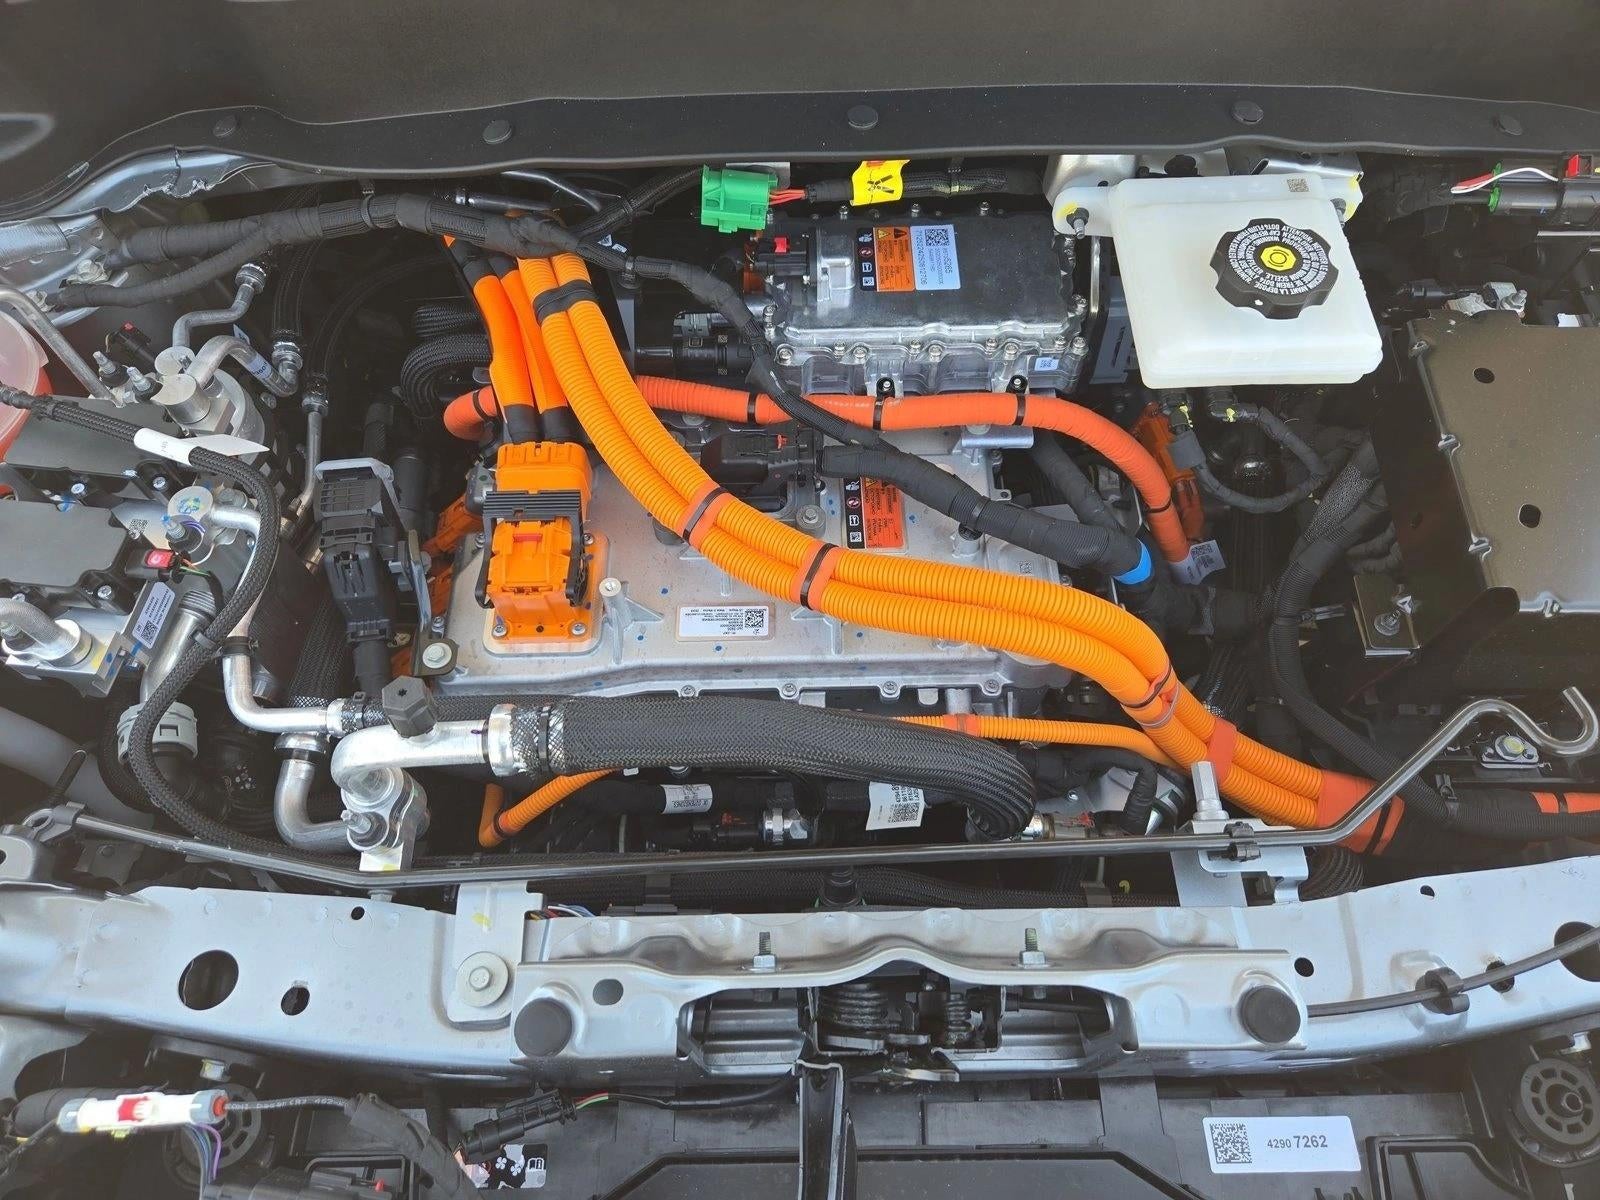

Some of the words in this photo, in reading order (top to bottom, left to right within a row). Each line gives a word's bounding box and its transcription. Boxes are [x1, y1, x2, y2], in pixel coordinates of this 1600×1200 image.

[1243, 267, 1259, 279] ONLY
[1259, 278, 1274, 286] DOT4
[1290, 285, 1309, 294] AVANT
[1267, 1138, 1292, 1149] 4290
[1293, 1135, 1328, 1149] 7262
